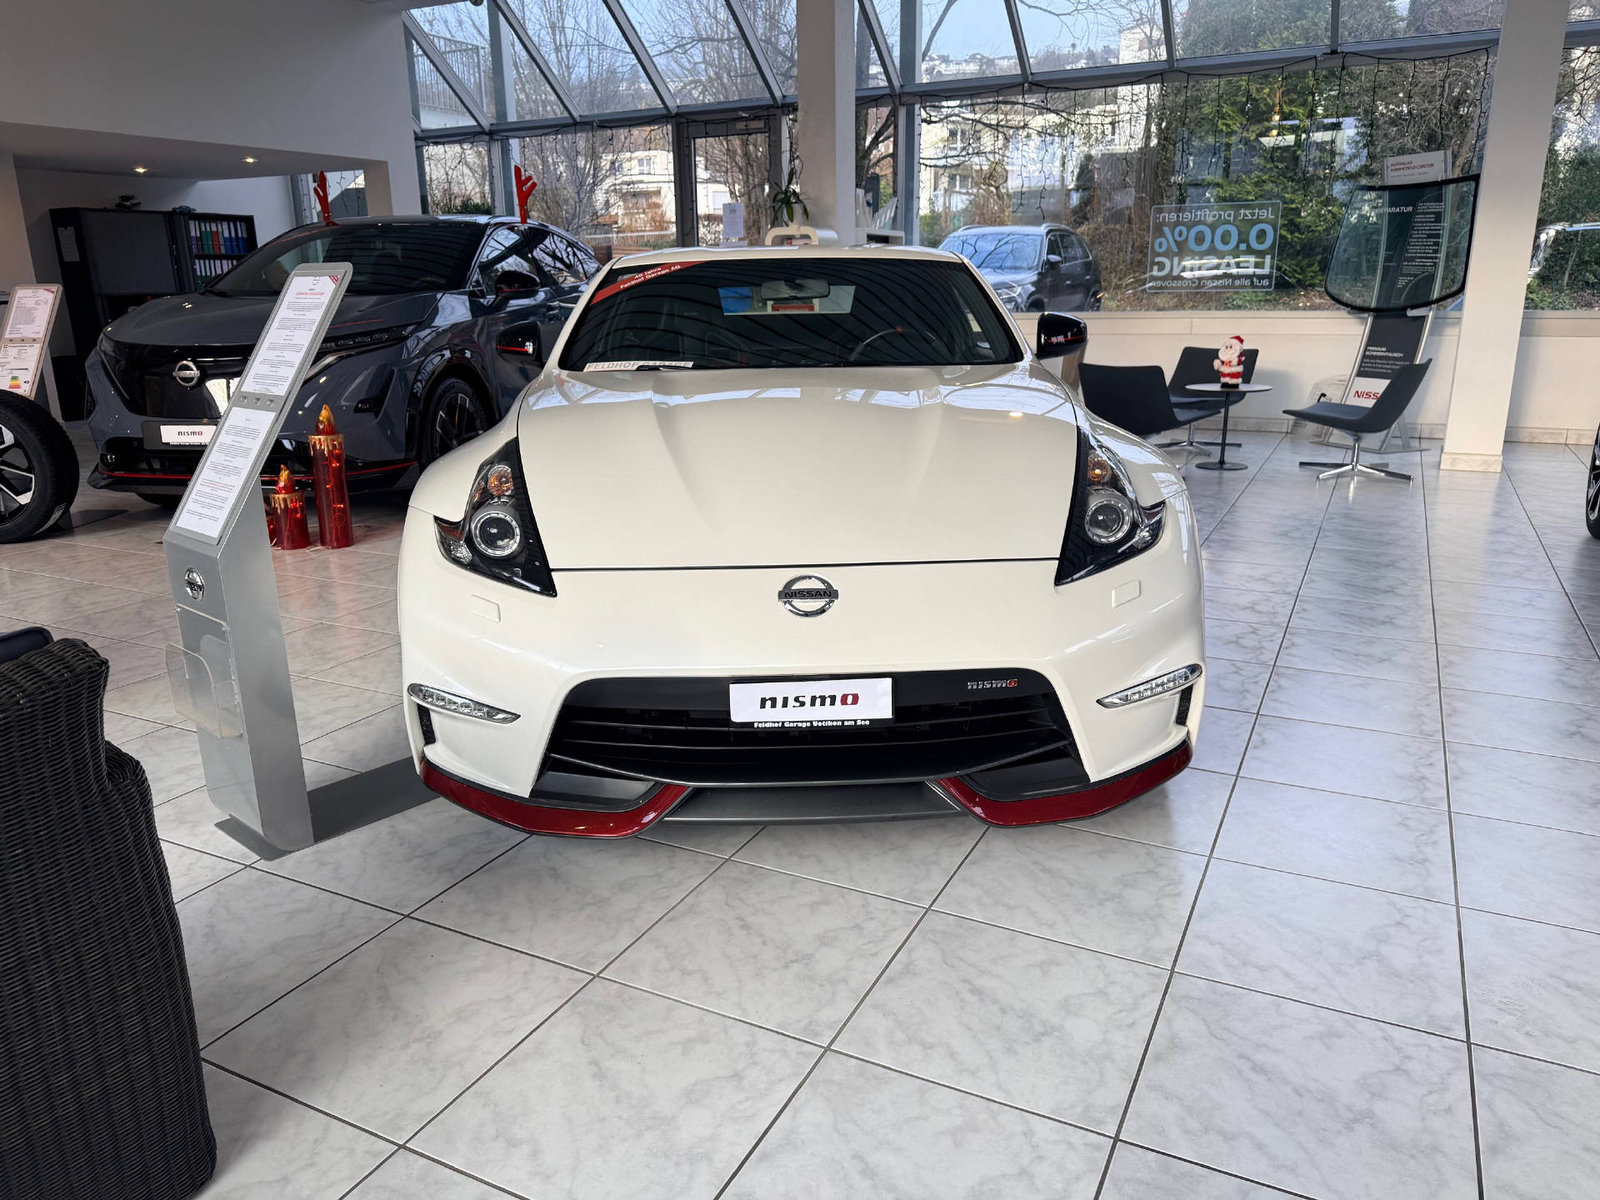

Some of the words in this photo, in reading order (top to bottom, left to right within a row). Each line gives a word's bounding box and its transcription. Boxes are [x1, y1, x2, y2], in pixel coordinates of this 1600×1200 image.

[784, 590, 832, 598] NISSAN
[967, 678, 1019, 690] nismo
[759, 692, 860, 710] nismo
[754, 721, 782, 729] Feldhof
